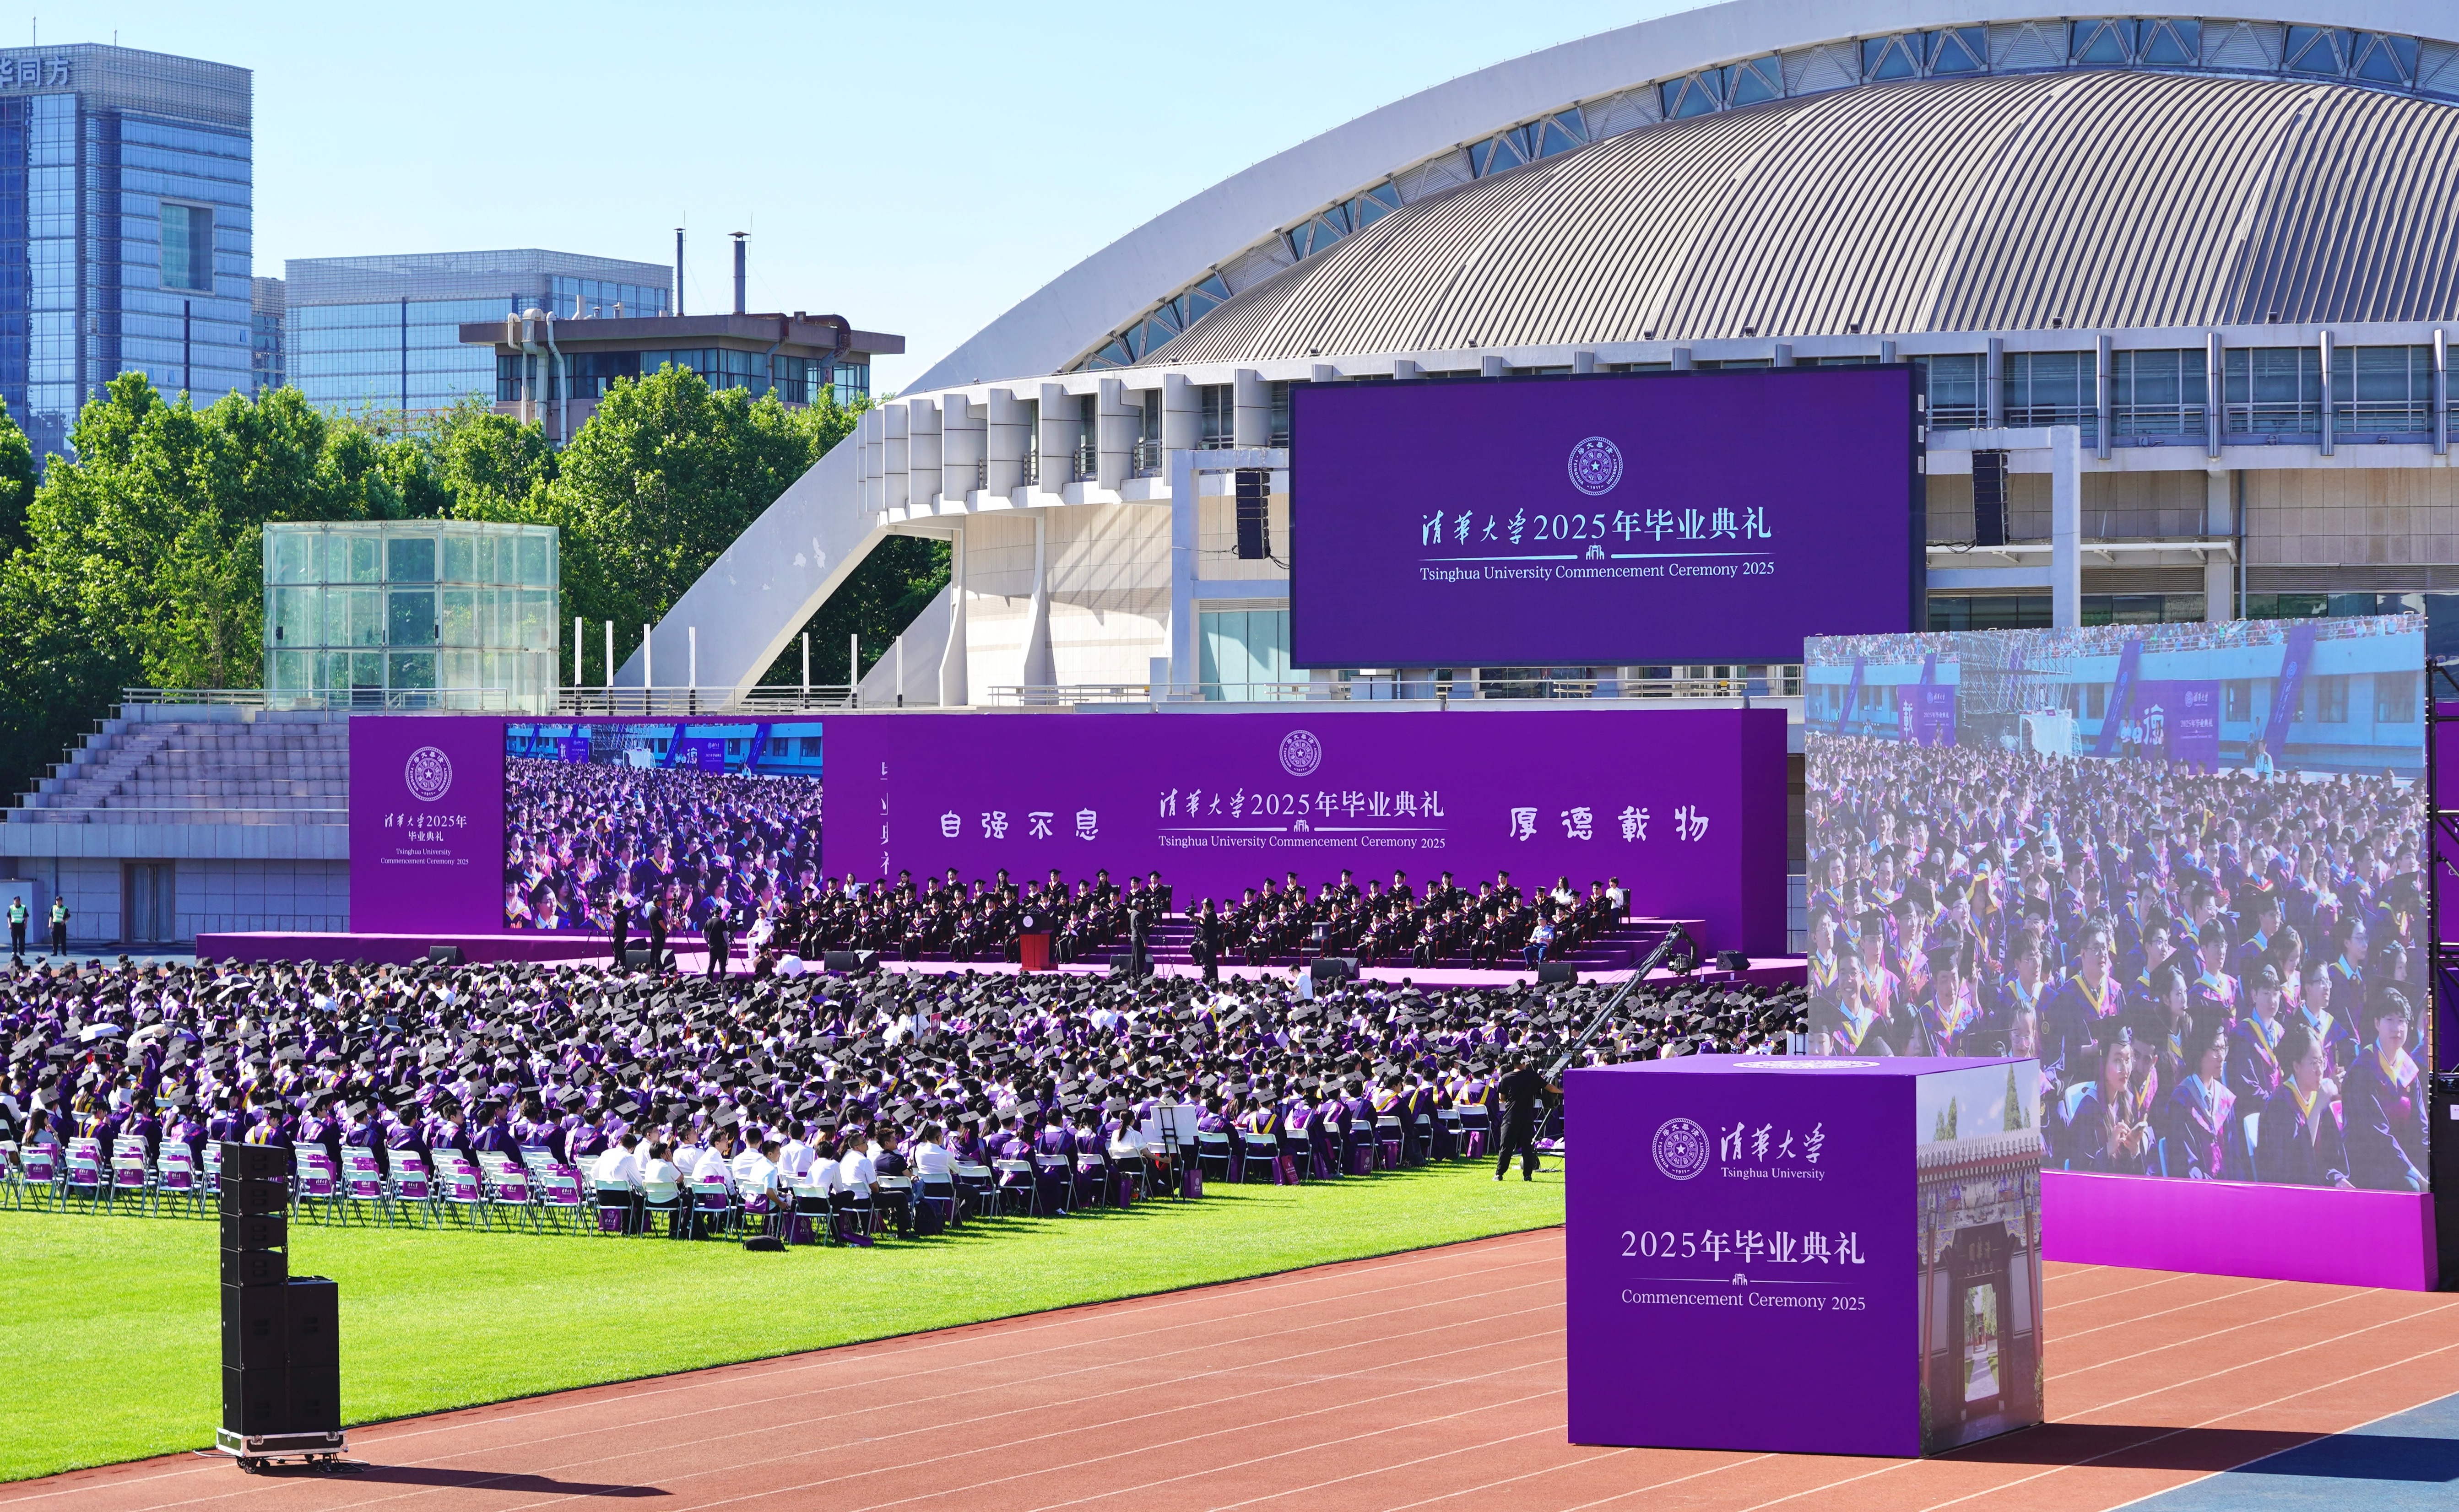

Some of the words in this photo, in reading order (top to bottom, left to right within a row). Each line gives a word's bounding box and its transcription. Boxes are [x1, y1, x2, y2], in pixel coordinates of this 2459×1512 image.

[1420, 567, 1480, 583] Tsinghua
[1484, 565, 1552, 580] University
[1555, 563, 1665, 578] Commencement
[1668, 562, 1739, 578] Ceremony
[1742, 561, 1775, 575] 2025
[408, 831, 444, 842] 毕业典礼
[1158, 835, 1208, 848] Tsinghua
[1211, 836, 1267, 849] University
[1269, 836, 1358, 847] Commencement
[1361, 836, 1417, 849] Ceremony
[1421, 837, 1446, 849] 2025
[396, 848, 422, 856] Tsinghua
[422, 848, 451, 856] University
[426, 858, 455, 866] Ceremony
[1658, 1141, 1669, 1169] TSINGHUA
[1692, 1142, 1704, 1169] UNIVERSITY
[1721, 1167, 1769, 1181] Tsinghua
[1771, 1168, 1825, 1181] University
[1621, 1229, 1866, 1265] 2025年毕业典礼
[1621, 1289, 1744, 1307] Commencement
[1748, 1291, 1826, 1311] Ceremony
[1831, 1296, 1866, 1311] 2025
